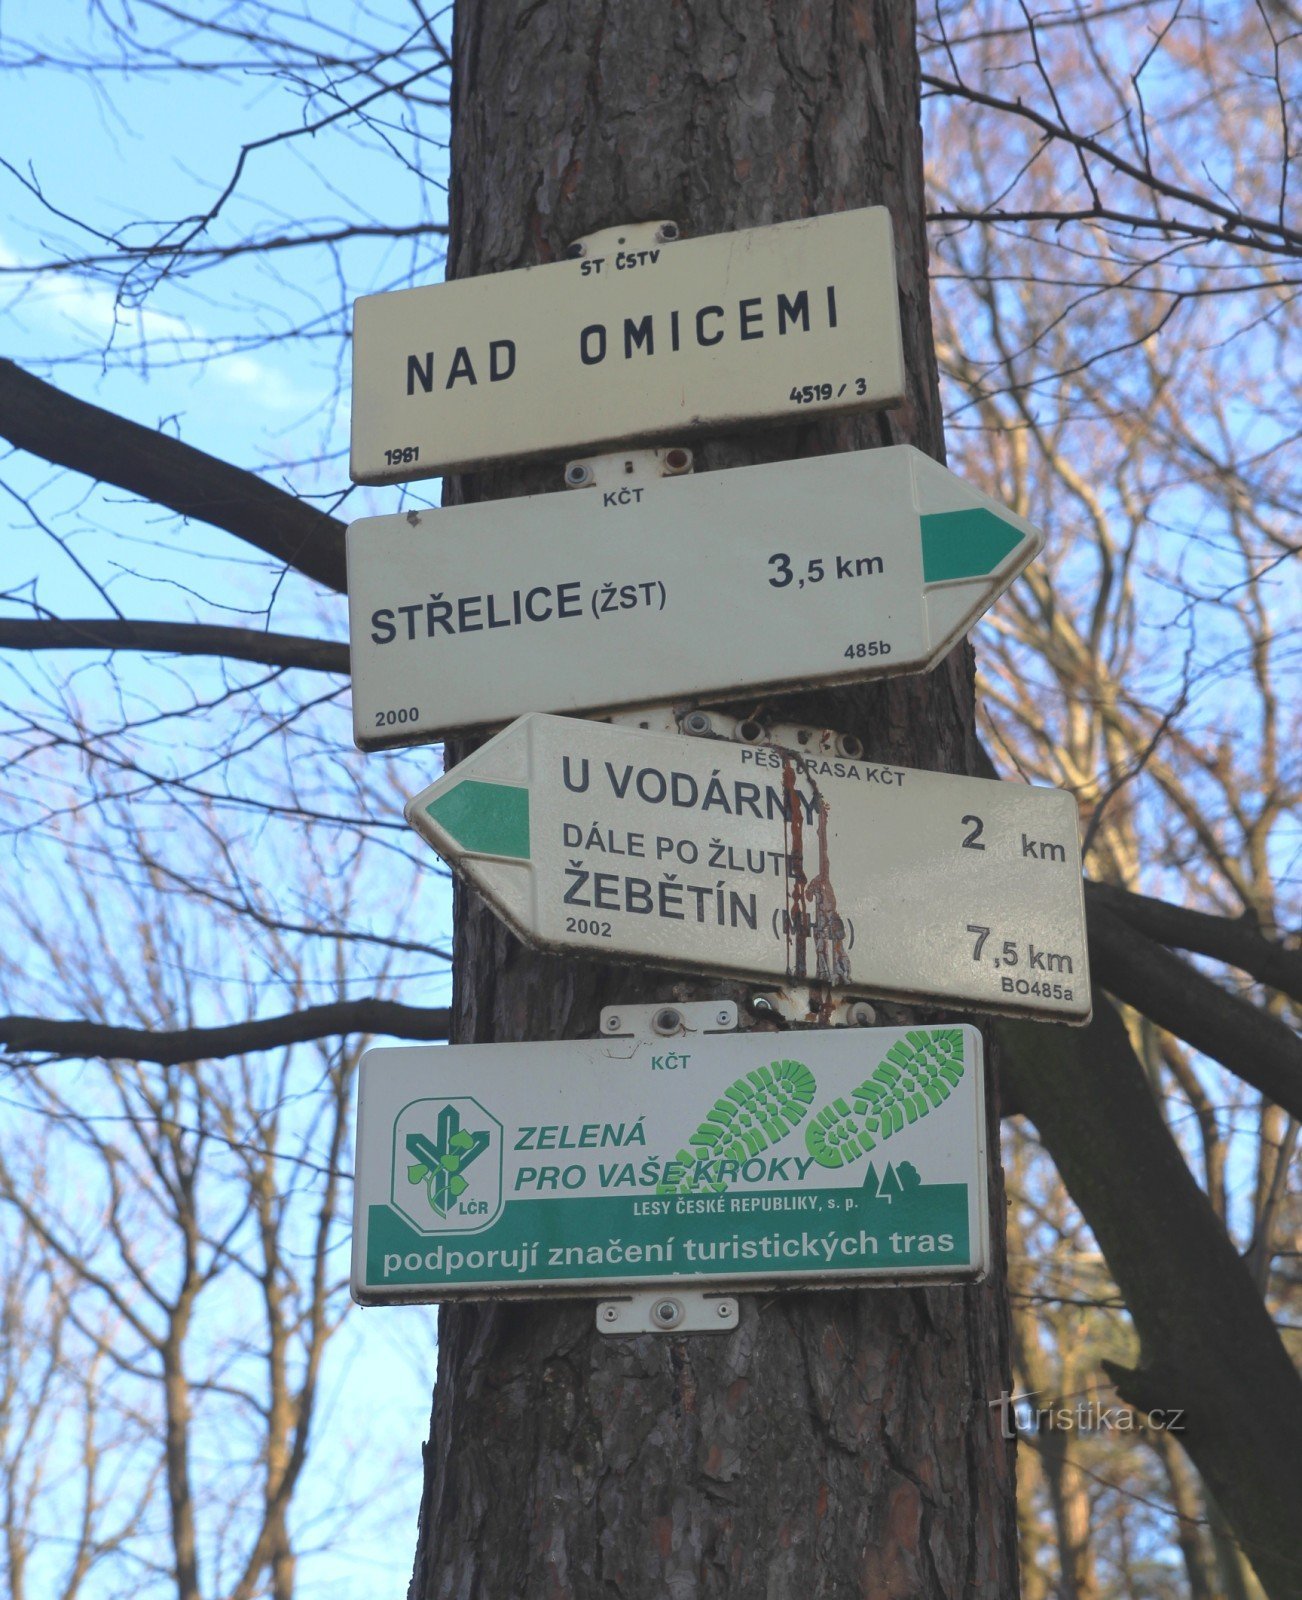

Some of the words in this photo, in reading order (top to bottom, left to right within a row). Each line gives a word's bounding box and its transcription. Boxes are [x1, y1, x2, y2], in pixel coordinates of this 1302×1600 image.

[580, 257, 604, 276] ST
[615, 249, 660, 270] ČSTV
[406, 339, 517, 396] NAD
[579, 286, 838, 366] OMICEMI
[789, 383, 833, 404] 4519
[855, 377, 867, 396] 3
[384, 446, 419, 466] 1981
[603, 487, 644, 508] KČT
[370, 581, 583, 645] STŘELICE
[591, 580, 667, 619] (ŽST)
[767, 552, 825, 589] 3,5
[836, 554, 884, 580] km
[844, 640, 892, 660] 485b
[375, 706, 420, 727] 2000
[795, 757, 861, 781] RASA
[866, 766, 906, 787] KČT
[562, 756, 590, 793] U
[604, 761, 820, 826] VODÁRNY
[961, 814, 986, 851] 2
[1021, 833, 1066, 863] km
[562, 822, 645, 858] DÁLE
[656, 836, 698, 866] PO
[562, 860, 758, 931] ŽEBĚTÍN
[966, 924, 1019, 969] 7,5
[1028, 944, 1074, 975] km
[566, 917, 612, 938] 2002
[1001, 977, 1074, 1002] BO485a
[651, 1052, 691, 1071] KČT
[514, 1116, 647, 1151] ZELENÁ
[514, 1165, 587, 1191] PRO
[598, 1156, 684, 1188] VAŠE
[692, 1156, 815, 1186] KROKY
[459, 1198, 488, 1215] LČR
[633, 1201, 671, 1216] LESY
[675, 1195, 725, 1214] ČESKÉ
[730, 1196, 822, 1213] REPUBLIKY,
[828, 1198, 840, 1209] s.
[845, 1197, 858, 1212] p.
[383, 1241, 538, 1277] podporují
[548, 1236, 674, 1267] značení
[683, 1230, 879, 1263] turistických
[888, 1228, 955, 1255] tras
